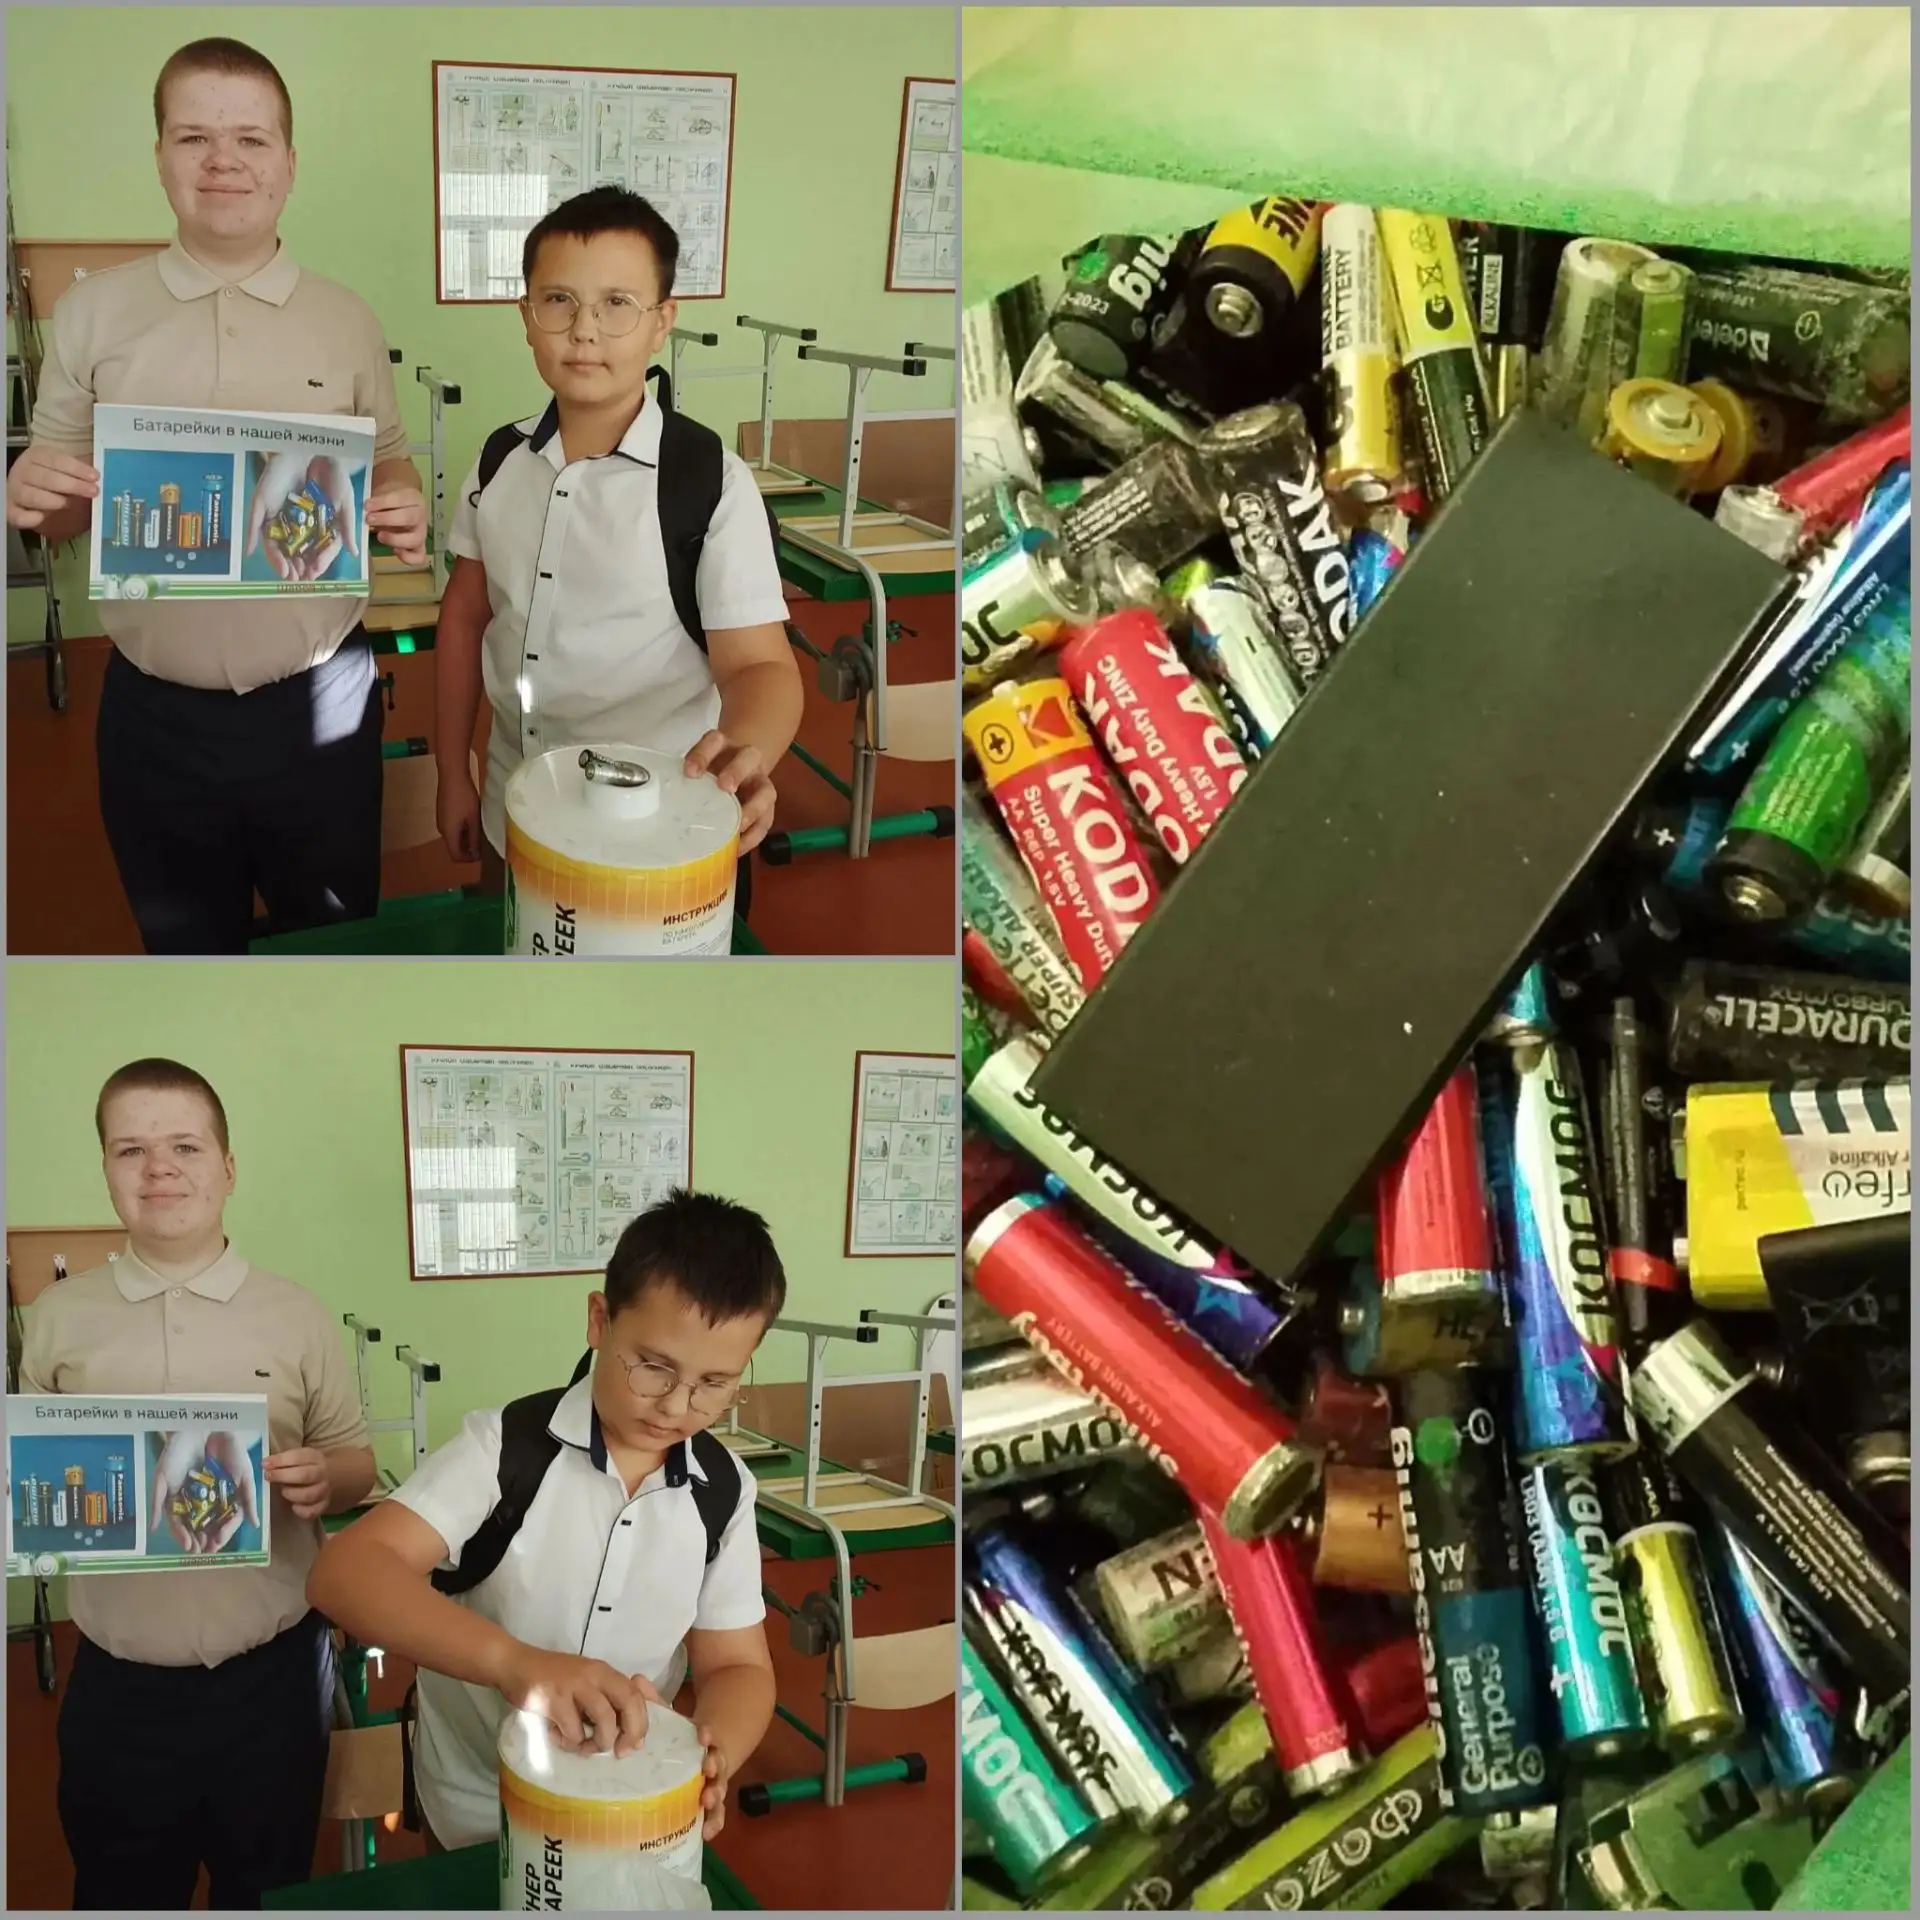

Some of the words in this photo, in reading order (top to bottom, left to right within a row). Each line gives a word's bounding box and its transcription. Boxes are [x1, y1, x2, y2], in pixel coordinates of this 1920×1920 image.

[1335, 248, 1353, 350] BATTERY
[1482, 257, 1501, 331] ALKALINE
[133, 417, 221, 437] Батарейки
[226, 425, 236, 437] в
[240, 426, 293, 443] нашей
[297, 433, 346, 448] жизни
[1278, 462, 1361, 643] ODAK
[1096, 653, 1139, 709] ZINC
[1130, 706, 1168, 760] Duty
[1144, 639, 1249, 797] ODAK
[1082, 671, 1190, 865] ODAK
[1159, 755, 1205, 824] Heavy
[1023, 784, 1060, 850] Super
[1051, 848, 1095, 921] Heavy
[555, 901, 576, 956] ЕЕК
[1017, 939, 1077, 1014] SUPER
[1714, 994, 1911, 1051] DURACELL
[1820, 1169, 1911, 1209] rfeo
[1828, 1148, 1899, 1168] Alkaline
[1543, 1077, 1614, 1317] КОСМОС
[1047, 1316, 1101, 1368] BATTERY
[35, 1405, 118, 1420] Батарейки
[123, 1409, 133, 1419] в
[137, 1407, 189, 1420] нашей
[192, 1409, 239, 1421] жизни
[1099, 1365, 1163, 1429] ALKALINE
[962, 1418, 1122, 1479] ОСМО
[1428, 1541, 1466, 1576] AA
[1446, 1654, 1486, 1796] General
[1476, 1642, 1519, 1792] Purpose
[522, 1862, 541, 1911] НЕР
[544, 1834, 562, 1911] АРЕЕК
